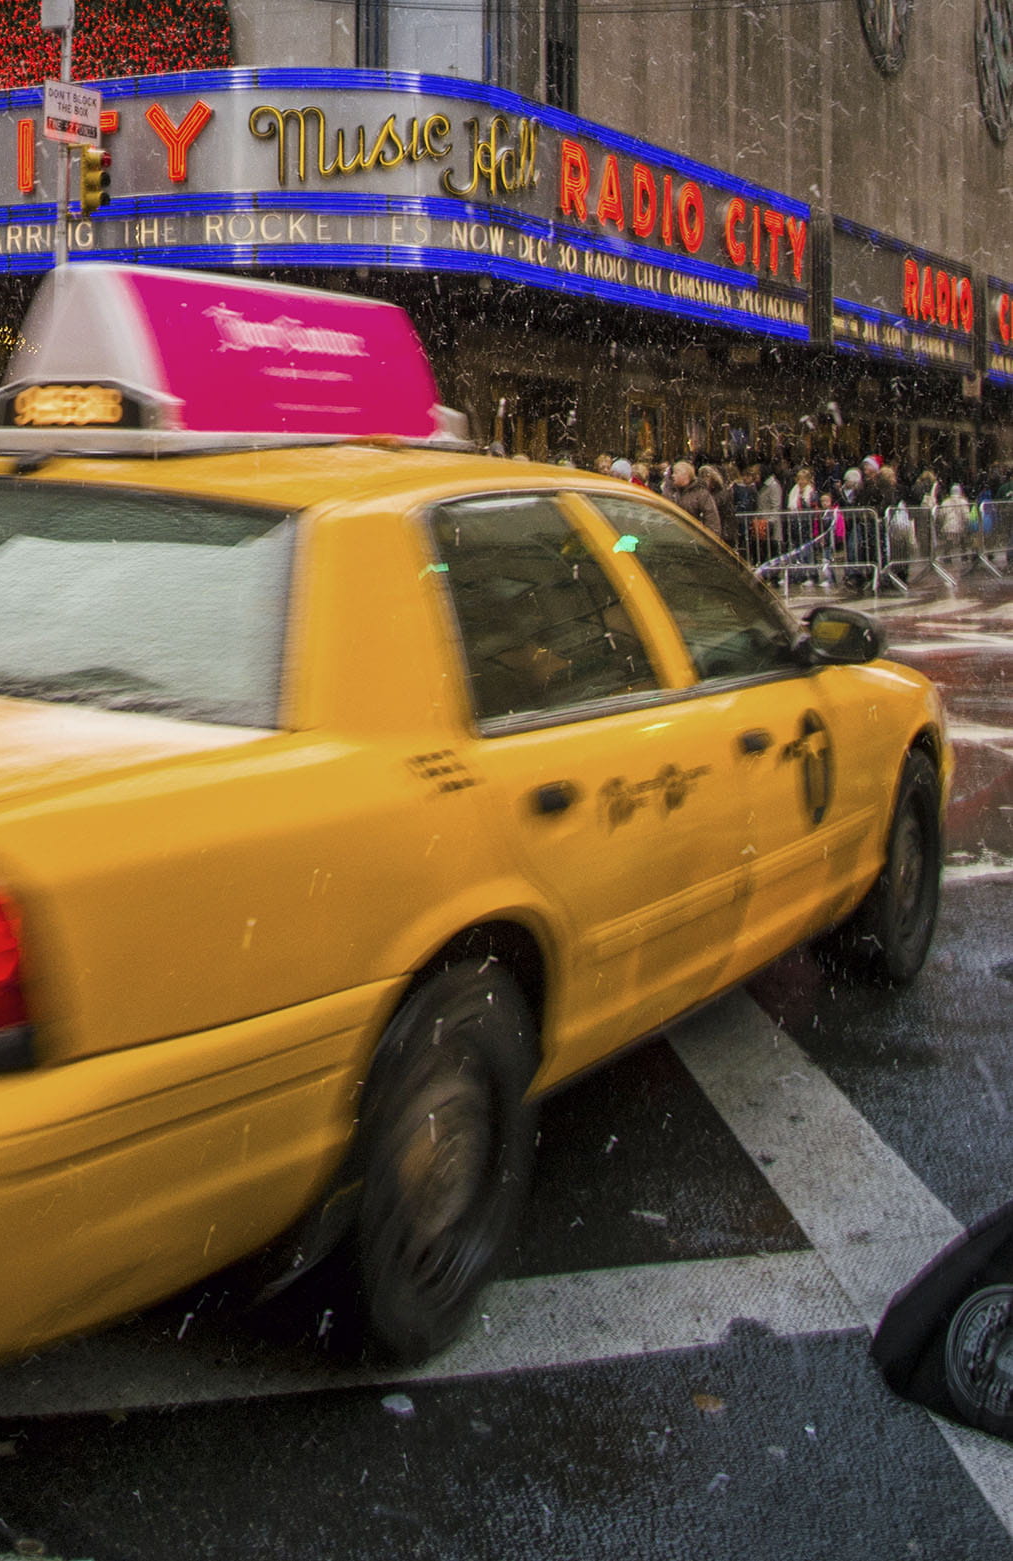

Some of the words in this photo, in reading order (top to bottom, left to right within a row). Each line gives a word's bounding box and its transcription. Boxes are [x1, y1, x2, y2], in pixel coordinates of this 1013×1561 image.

[58, 102, 72, 114] THE
[249, 105, 453, 185] Music
[444, 114, 541, 196] Hall
[561, 139, 706, 254] RADIO
[725, 197, 808, 282] CITY
[123, 217, 177, 246] THE
[558, 243, 578, 271] 30
[585, 249, 628, 282] RADIO
[904, 259, 974, 334] RADIO
